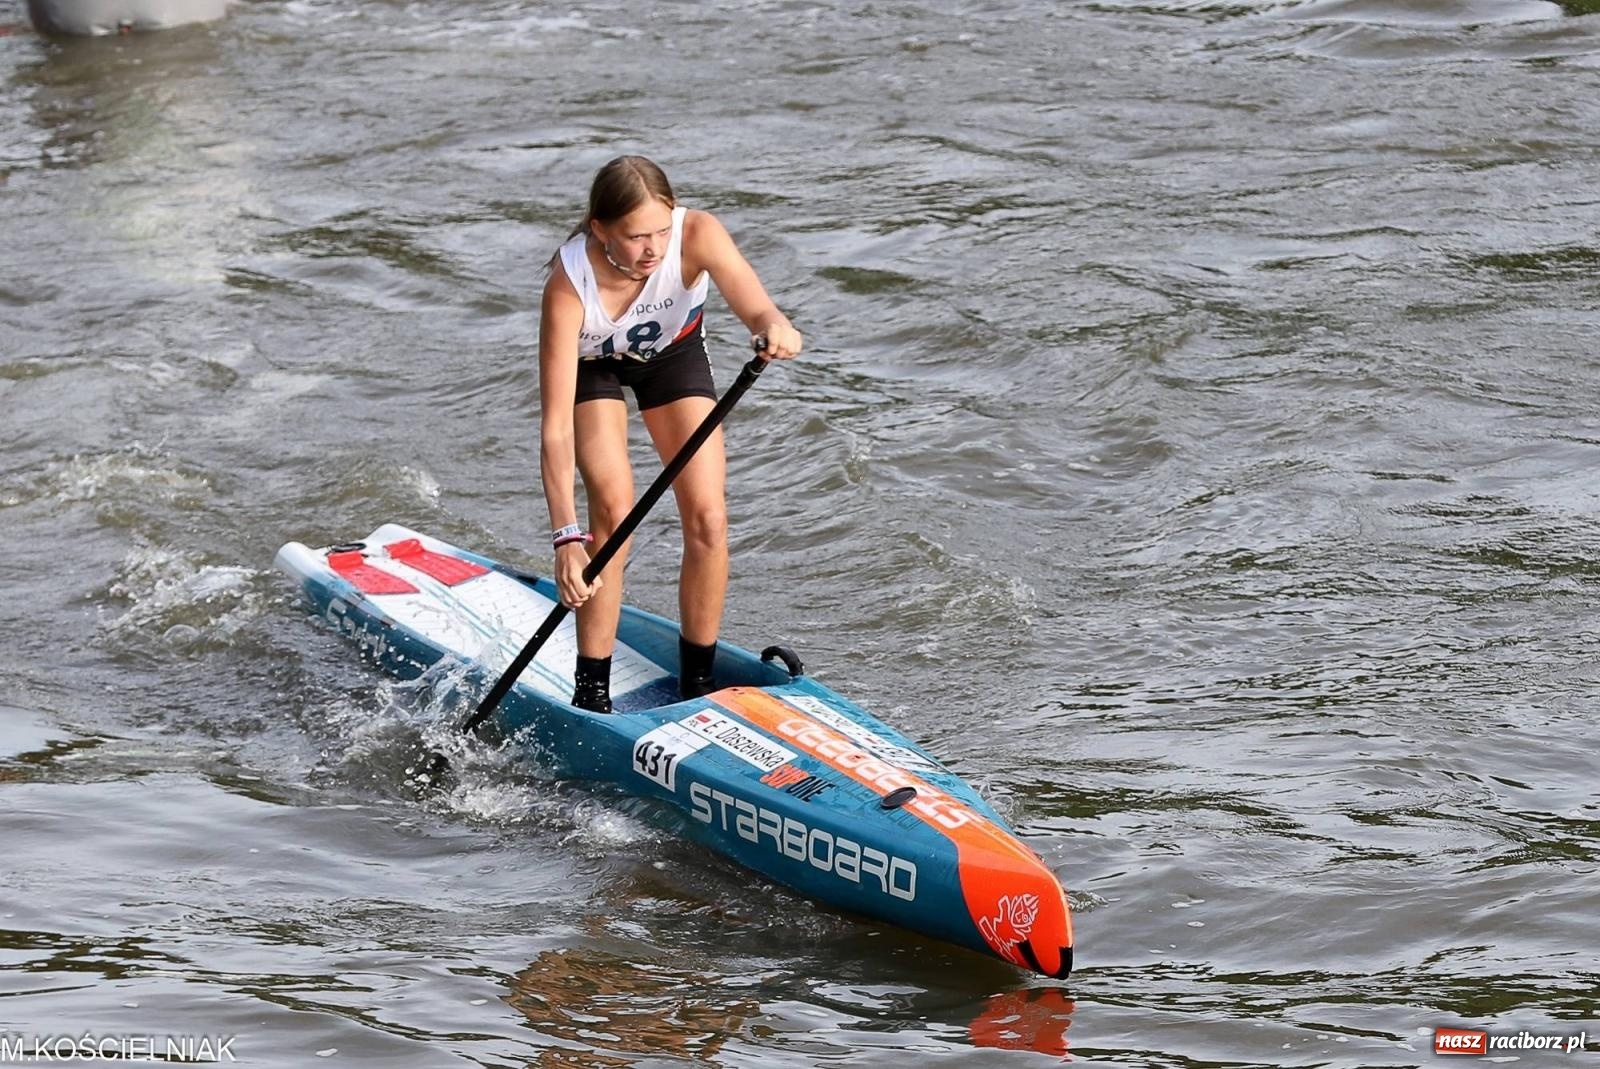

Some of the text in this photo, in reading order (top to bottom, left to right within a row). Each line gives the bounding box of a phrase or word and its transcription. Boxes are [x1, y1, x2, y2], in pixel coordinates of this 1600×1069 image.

[636, 740, 677, 785] 431
[702, 720, 727, 734] E.
[715, 726, 785, 768] Daszewska
